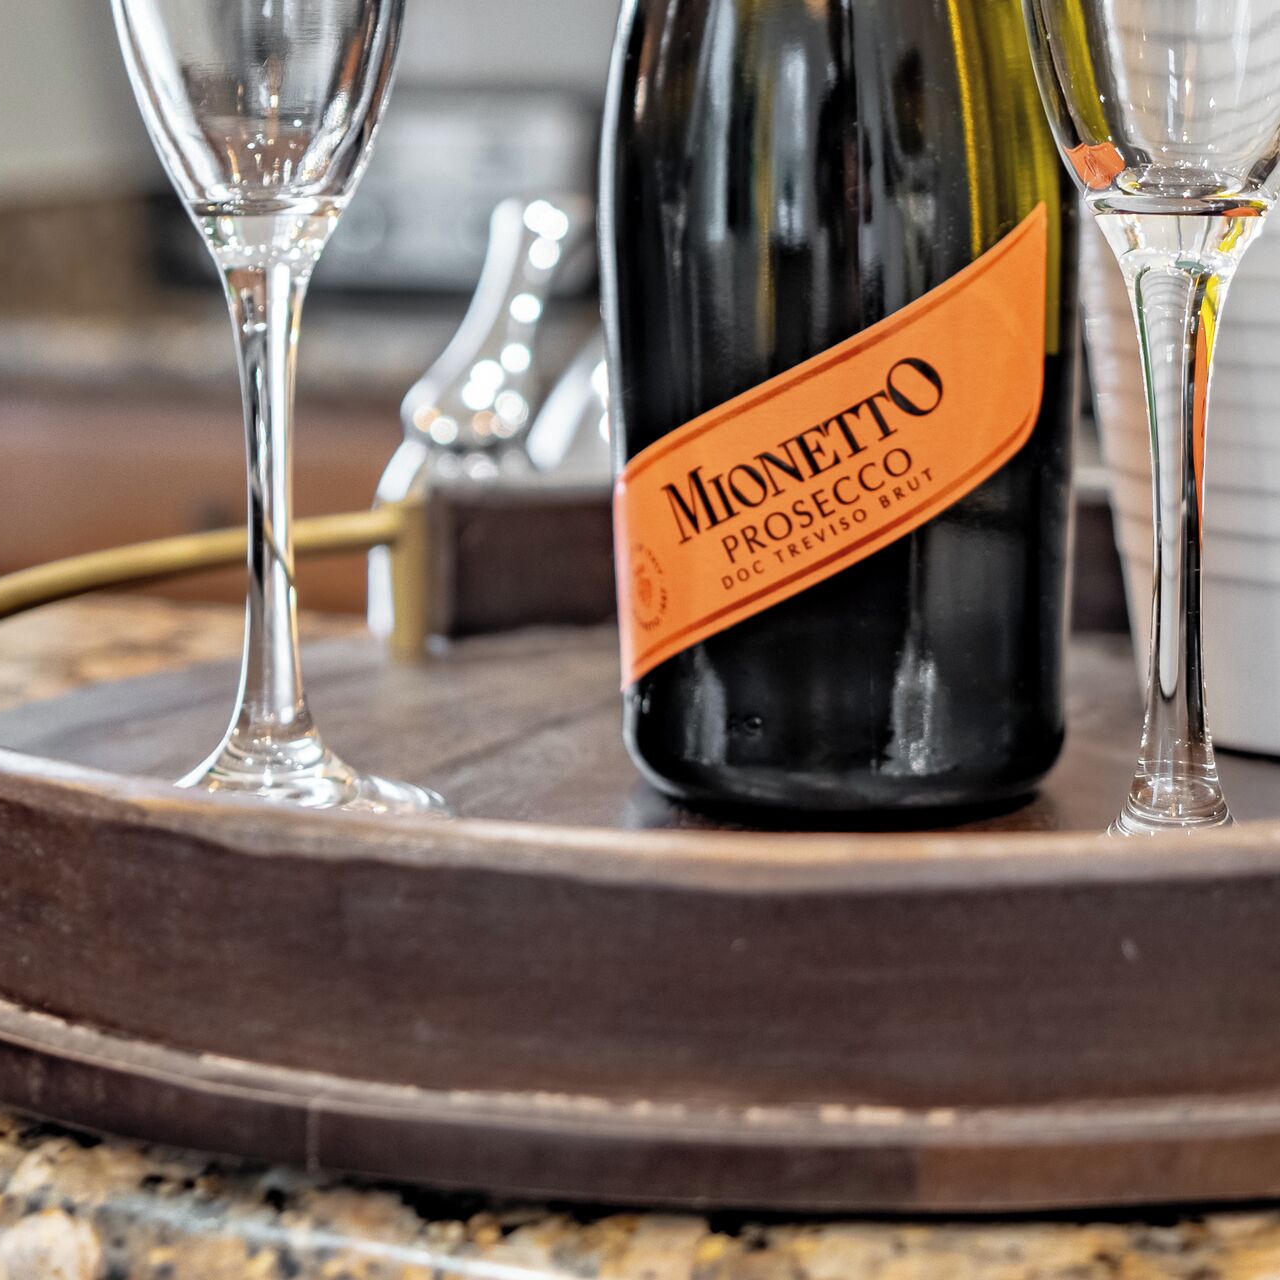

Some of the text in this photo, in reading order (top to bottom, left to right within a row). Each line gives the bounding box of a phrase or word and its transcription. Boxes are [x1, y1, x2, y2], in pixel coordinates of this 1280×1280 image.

[660, 356, 944, 546] MIONETTO
[721, 447, 912, 564] PROSECCO
[721, 467, 934, 590] DOC TREVISO BRUT
